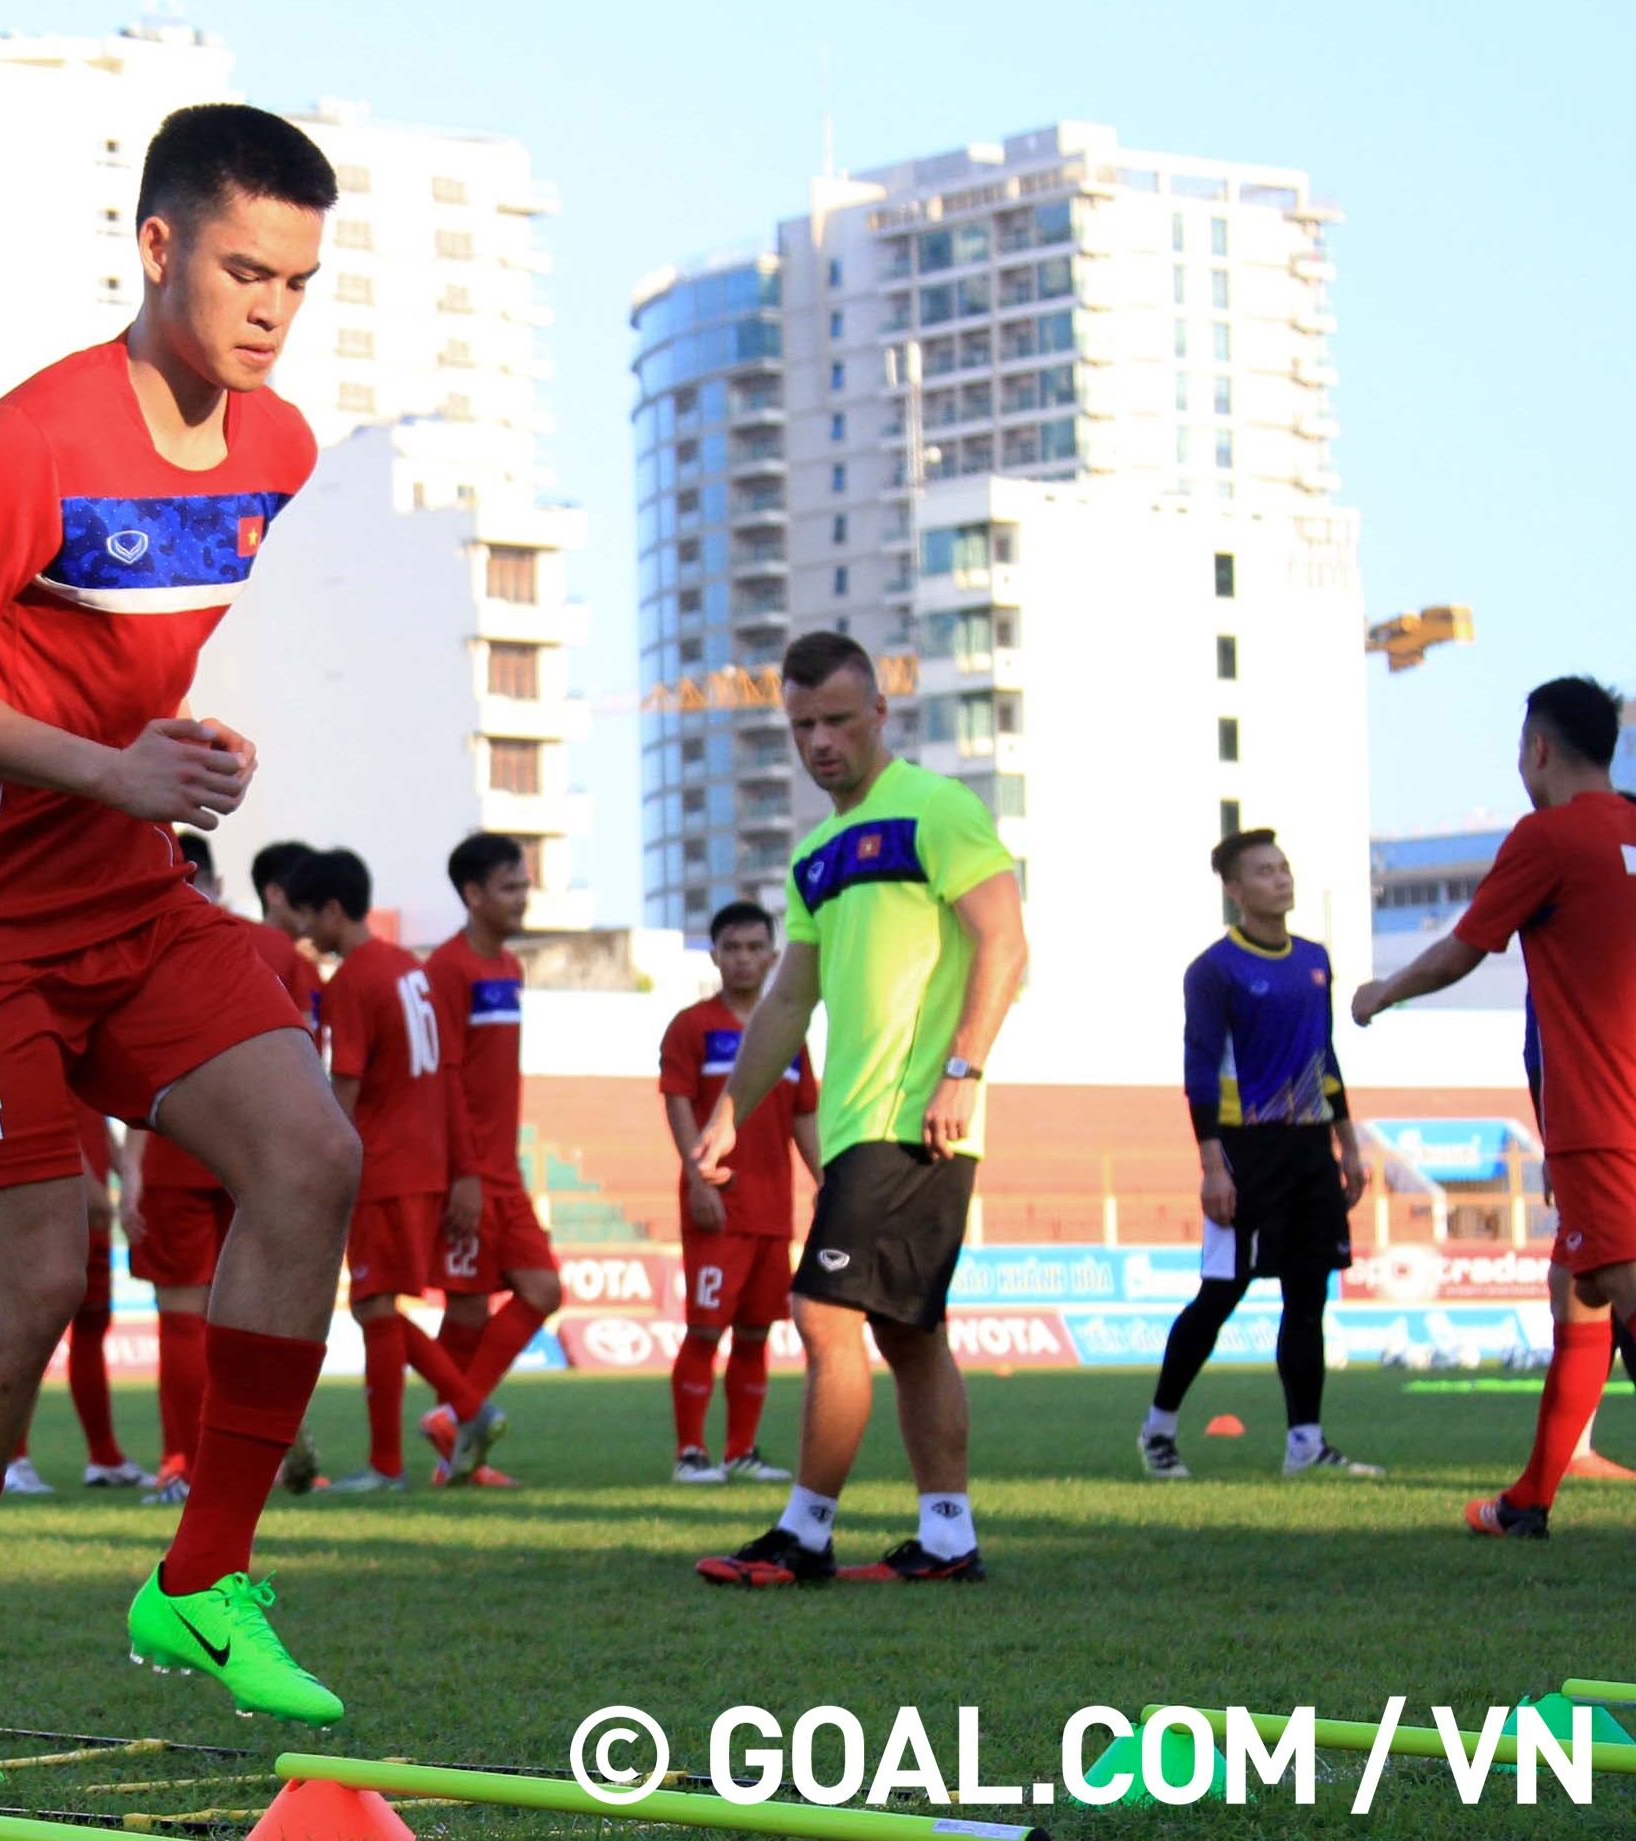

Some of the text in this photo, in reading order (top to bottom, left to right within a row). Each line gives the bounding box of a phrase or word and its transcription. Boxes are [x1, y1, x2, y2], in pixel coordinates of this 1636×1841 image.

[396, 967, 440, 1079] 16
[560, 1259, 653, 1300] YOTA
[695, 1266, 724, 1311] 12
